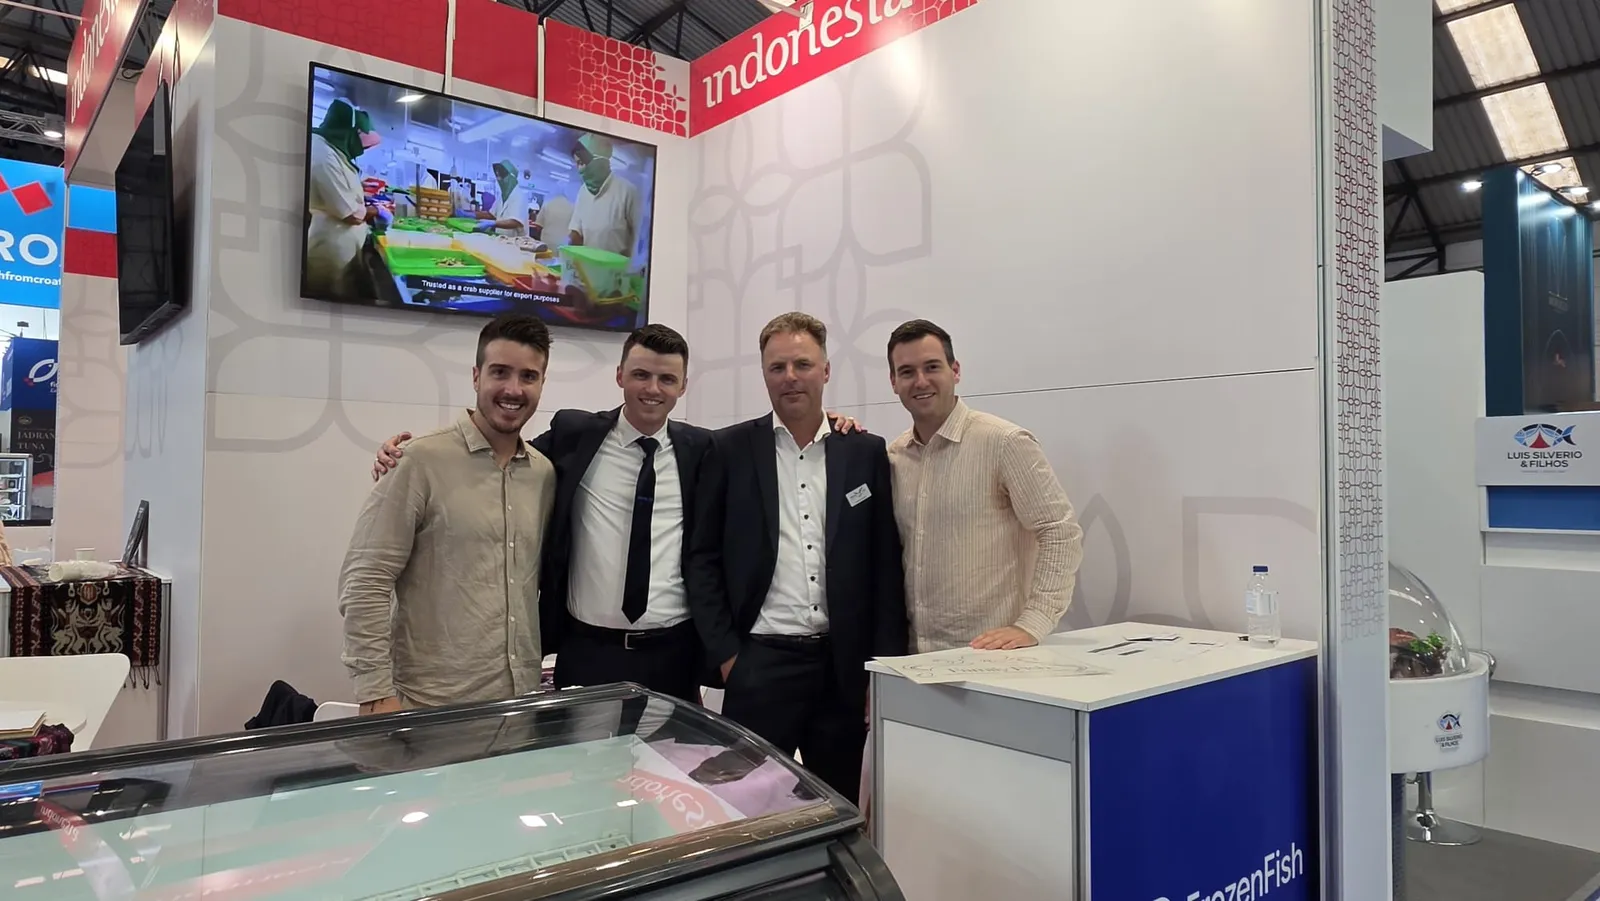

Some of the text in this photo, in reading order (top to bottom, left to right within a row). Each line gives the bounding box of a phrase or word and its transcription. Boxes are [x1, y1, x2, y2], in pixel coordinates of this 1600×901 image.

[421, 279, 447, 290] Trusted
[462, 285, 477, 293] crab
[478, 287, 503, 297] supplier
[503, 289, 513, 297] for
[513, 291, 533, 301] export
[533, 294, 560, 303] purposes
[17, 442, 45, 451] TUNA
[1507, 450, 1583, 460] LUIS SILVERIO
[1520, 459, 1569, 468] & FILHOS
[1187, 842, 1303, 901] zenFish
